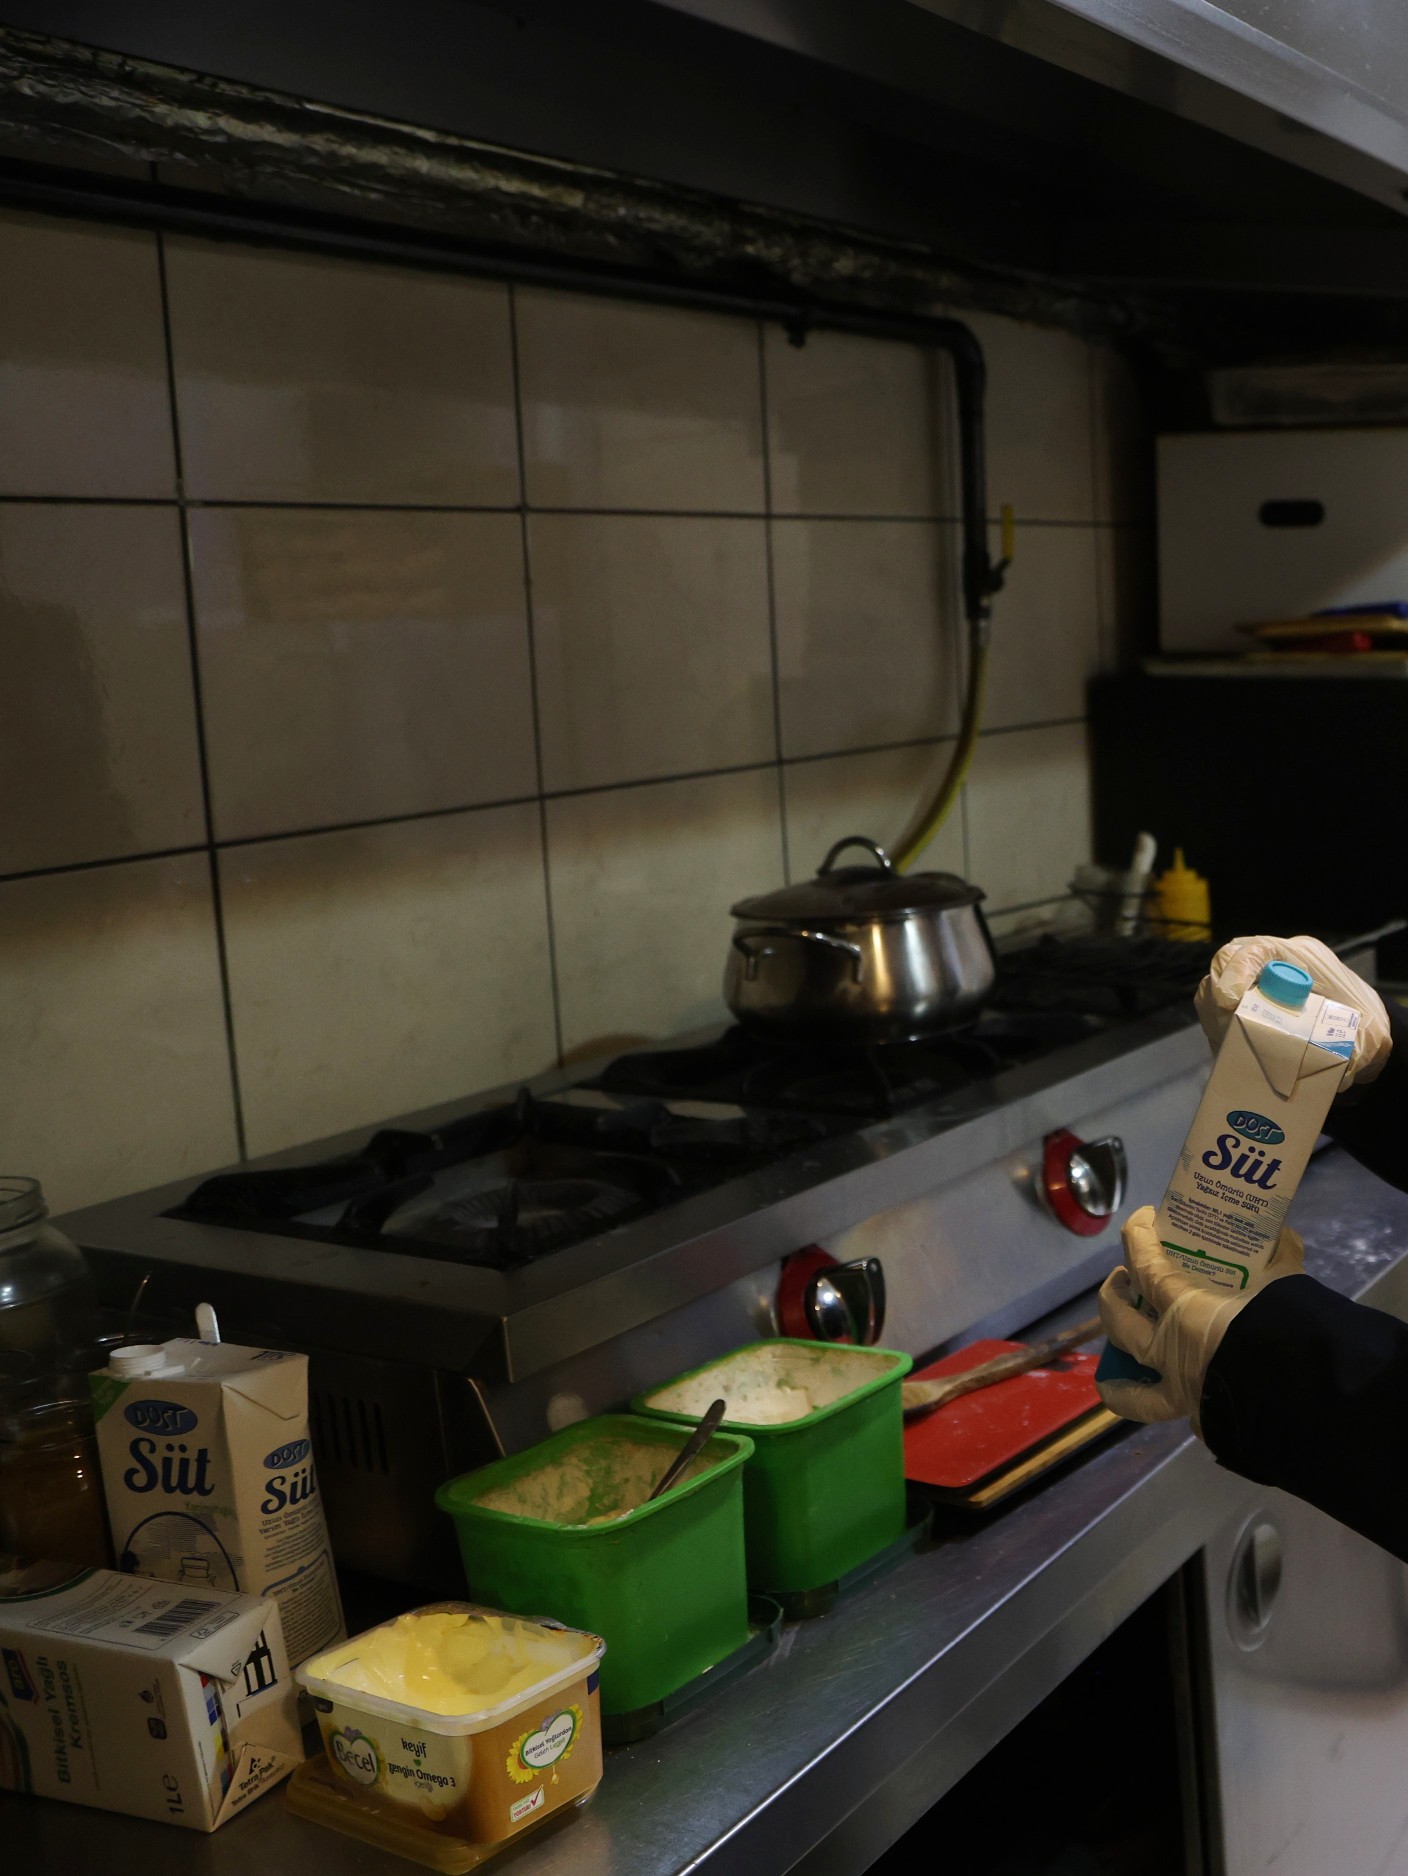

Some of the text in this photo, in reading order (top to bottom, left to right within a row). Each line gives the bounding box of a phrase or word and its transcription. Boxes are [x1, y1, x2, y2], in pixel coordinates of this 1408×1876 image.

[1233, 1113, 1283, 1140] DOST
[1202, 1134, 1283, 1190] Süt
[1193, 1171, 1269, 1208] Uzun Ömürlü (UHT)
[1196, 1181, 1219, 1197] Yağsız
[134, 1405, 189, 1431] DOST
[124, 1438, 215, 1496] Süt
[36, 1656, 71, 1783] Bitkisel Yağlı
[401, 1737, 427, 1758] keyif
[238, 1774, 259, 1791] Tetra
[416, 1769, 449, 1788] Omega
[449, 1777, 457, 1787] 3
